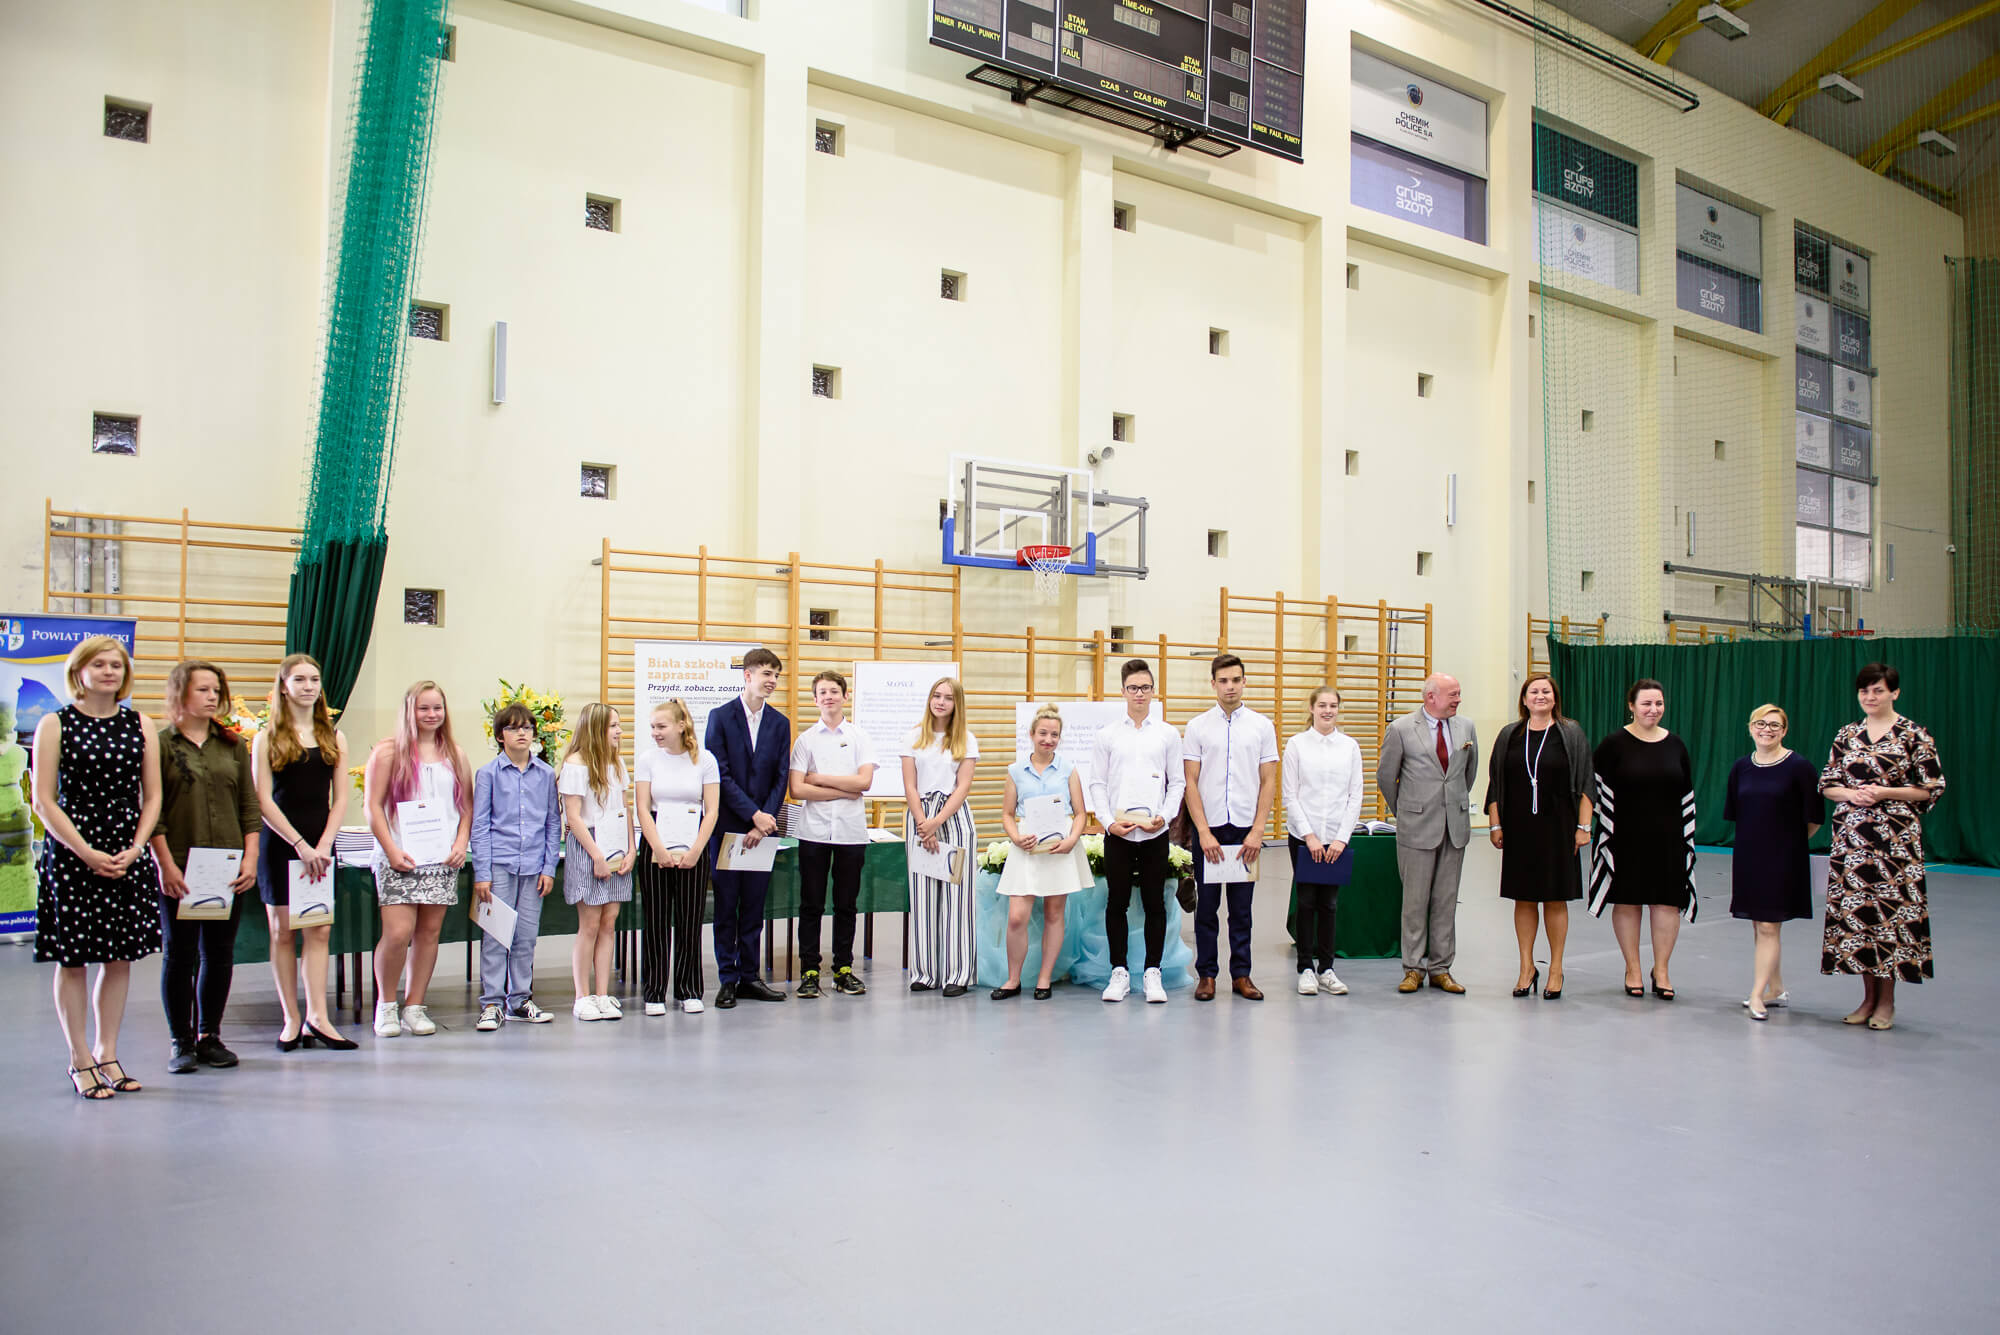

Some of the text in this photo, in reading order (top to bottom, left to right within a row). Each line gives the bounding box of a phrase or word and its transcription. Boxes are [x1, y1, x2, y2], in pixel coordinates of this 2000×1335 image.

[1122, 0, 1154, 16] TIME-OUT
[1067, 13, 1086, 26] STAN
[934, 13, 1000, 42] NUMER FAUL PUNKTY
[1062, 47, 1080, 60] FAUL
[1183, 55, 1200, 67] STAN
[1100, 79, 1120, 92] CZAS
[1133, 90, 1152, 103] CZAS
[1152, 96, 1167, 108] GRY
[1186, 89, 1202, 102] FAUL
[1395, 117, 1423, 135] POLICE
[1400, 111, 1429, 129] CHEMIK
[1269, 127, 1282, 140] FAUL
[32, 630, 80, 641] POWIAT
[648, 656, 681, 668] Biała
[684, 658, 726, 669] szkoła
[648, 670, 709, 682] zaprasza!
[684, 684, 715, 692] zobacz,
